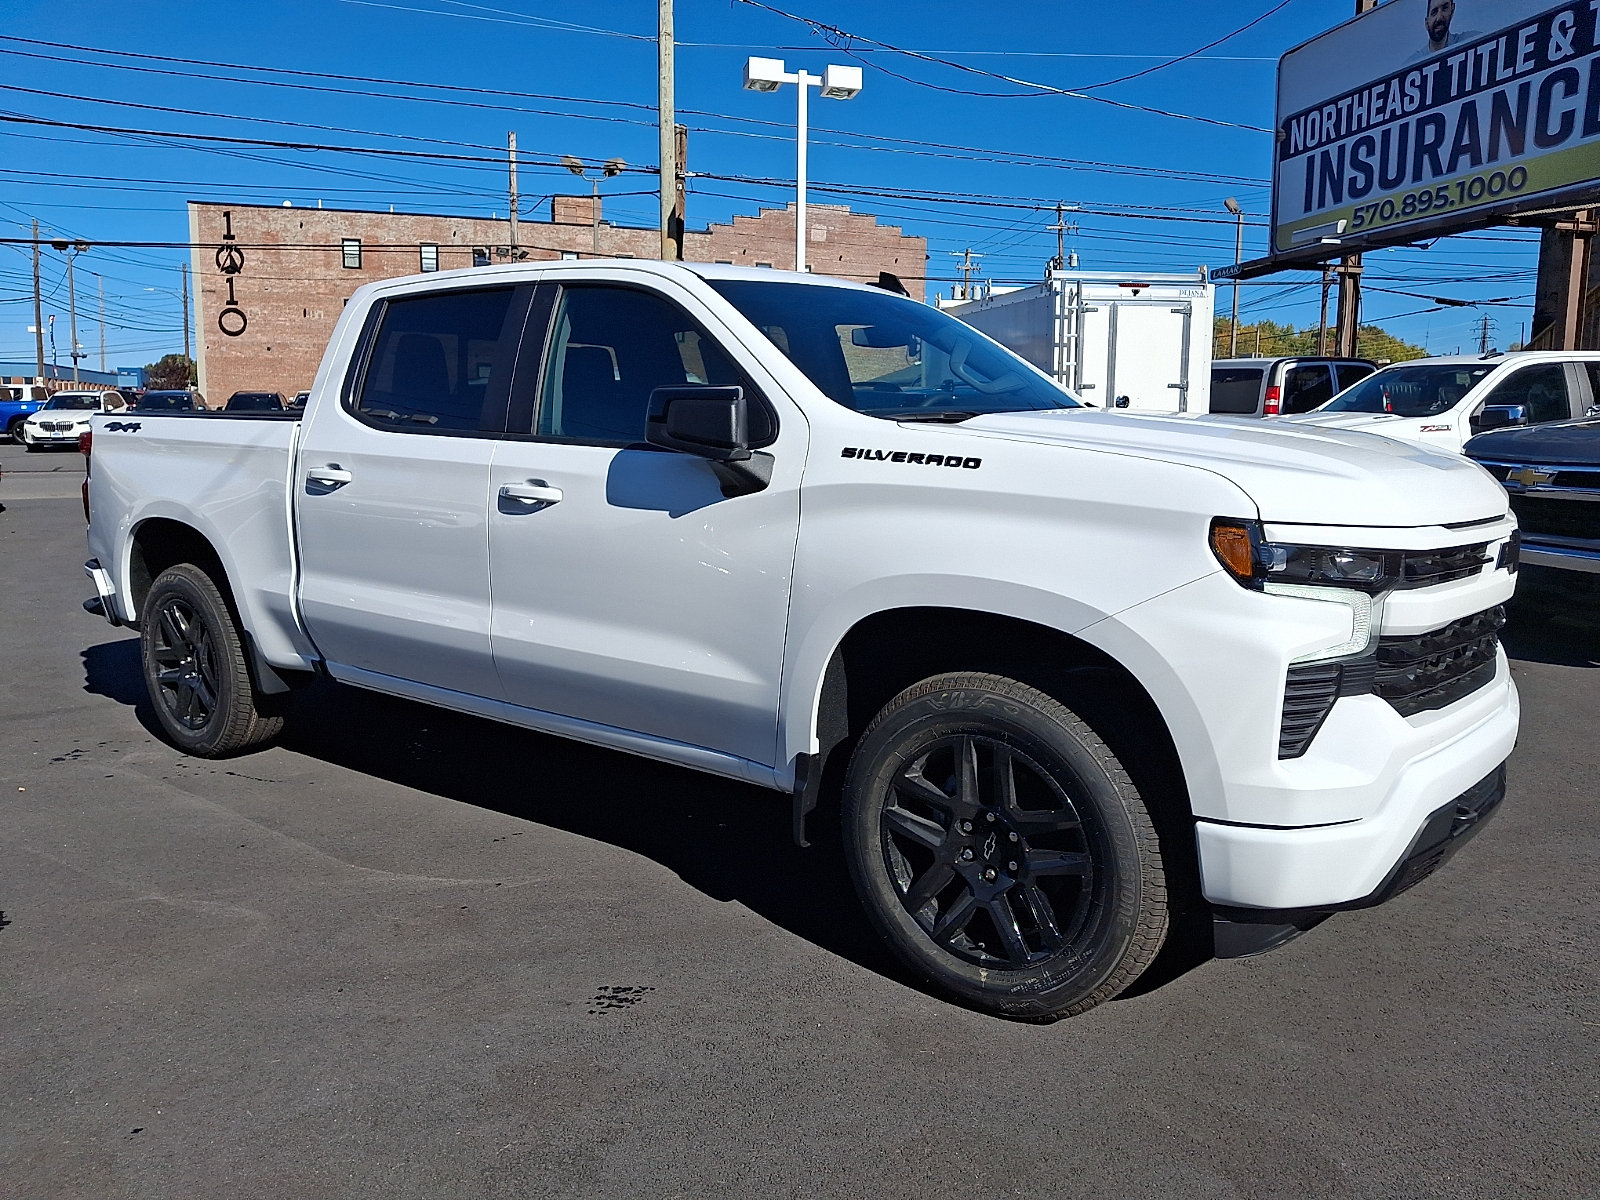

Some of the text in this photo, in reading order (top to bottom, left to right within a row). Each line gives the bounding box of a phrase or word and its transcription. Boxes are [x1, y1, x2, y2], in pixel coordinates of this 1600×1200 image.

[1290, 61, 1440, 154] NORTHEAST
[1447, 23, 1539, 98] TITLE
[1548, 10, 1577, 61] &
[1351, 166, 1528, 229] 570.895.1000
[1212, 264, 1240, 278] LAMAR
[840, 446, 983, 470] SILVERADO
